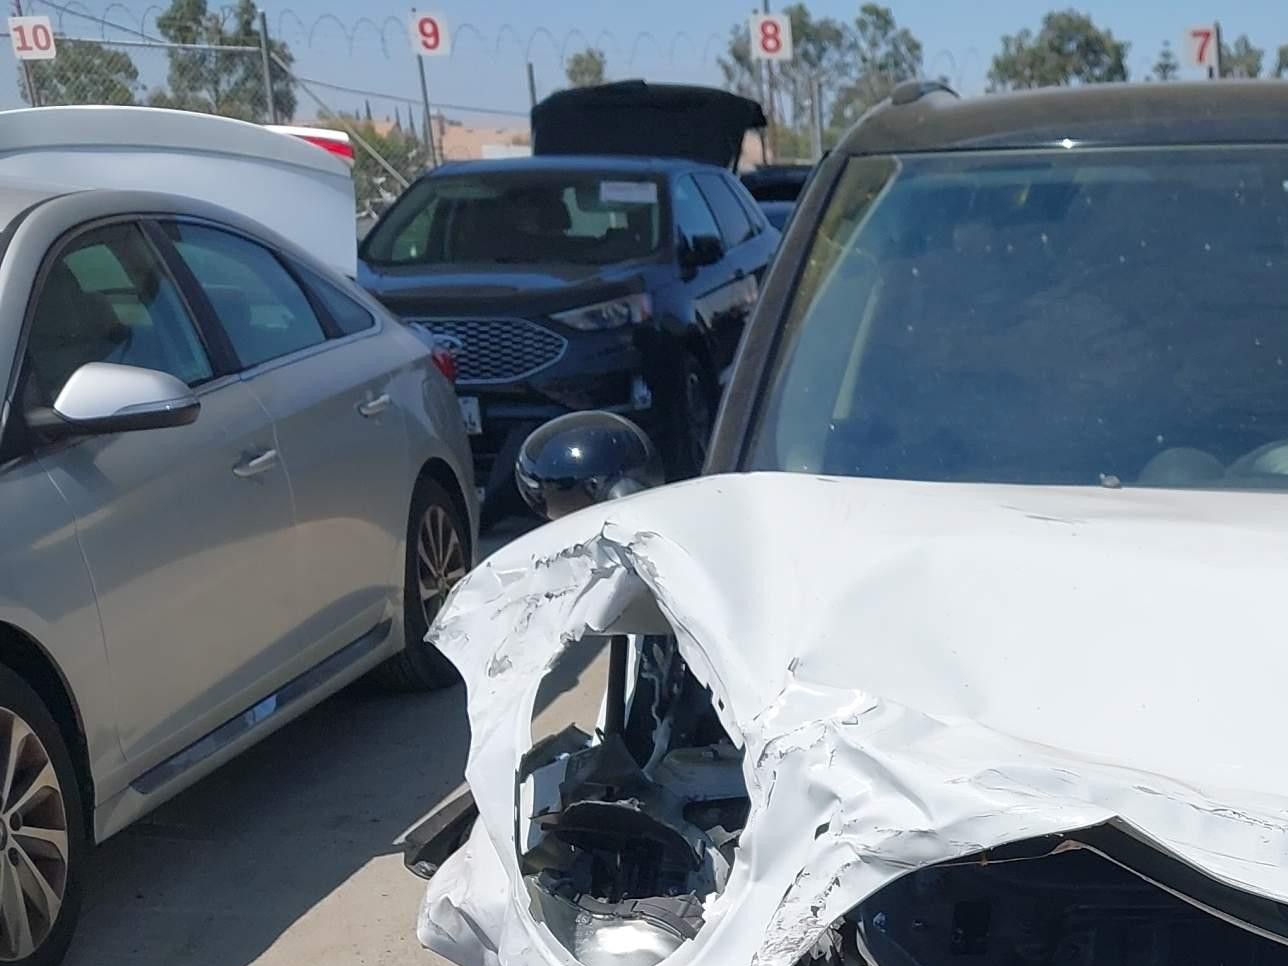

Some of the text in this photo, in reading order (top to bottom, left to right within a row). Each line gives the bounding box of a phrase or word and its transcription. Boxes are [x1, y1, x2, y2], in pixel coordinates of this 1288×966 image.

[13, 24, 51, 50] 10
[418, 17, 440, 50] 9
[761, 20, 782, 54] 8
[1191, 30, 1210, 63] 7
